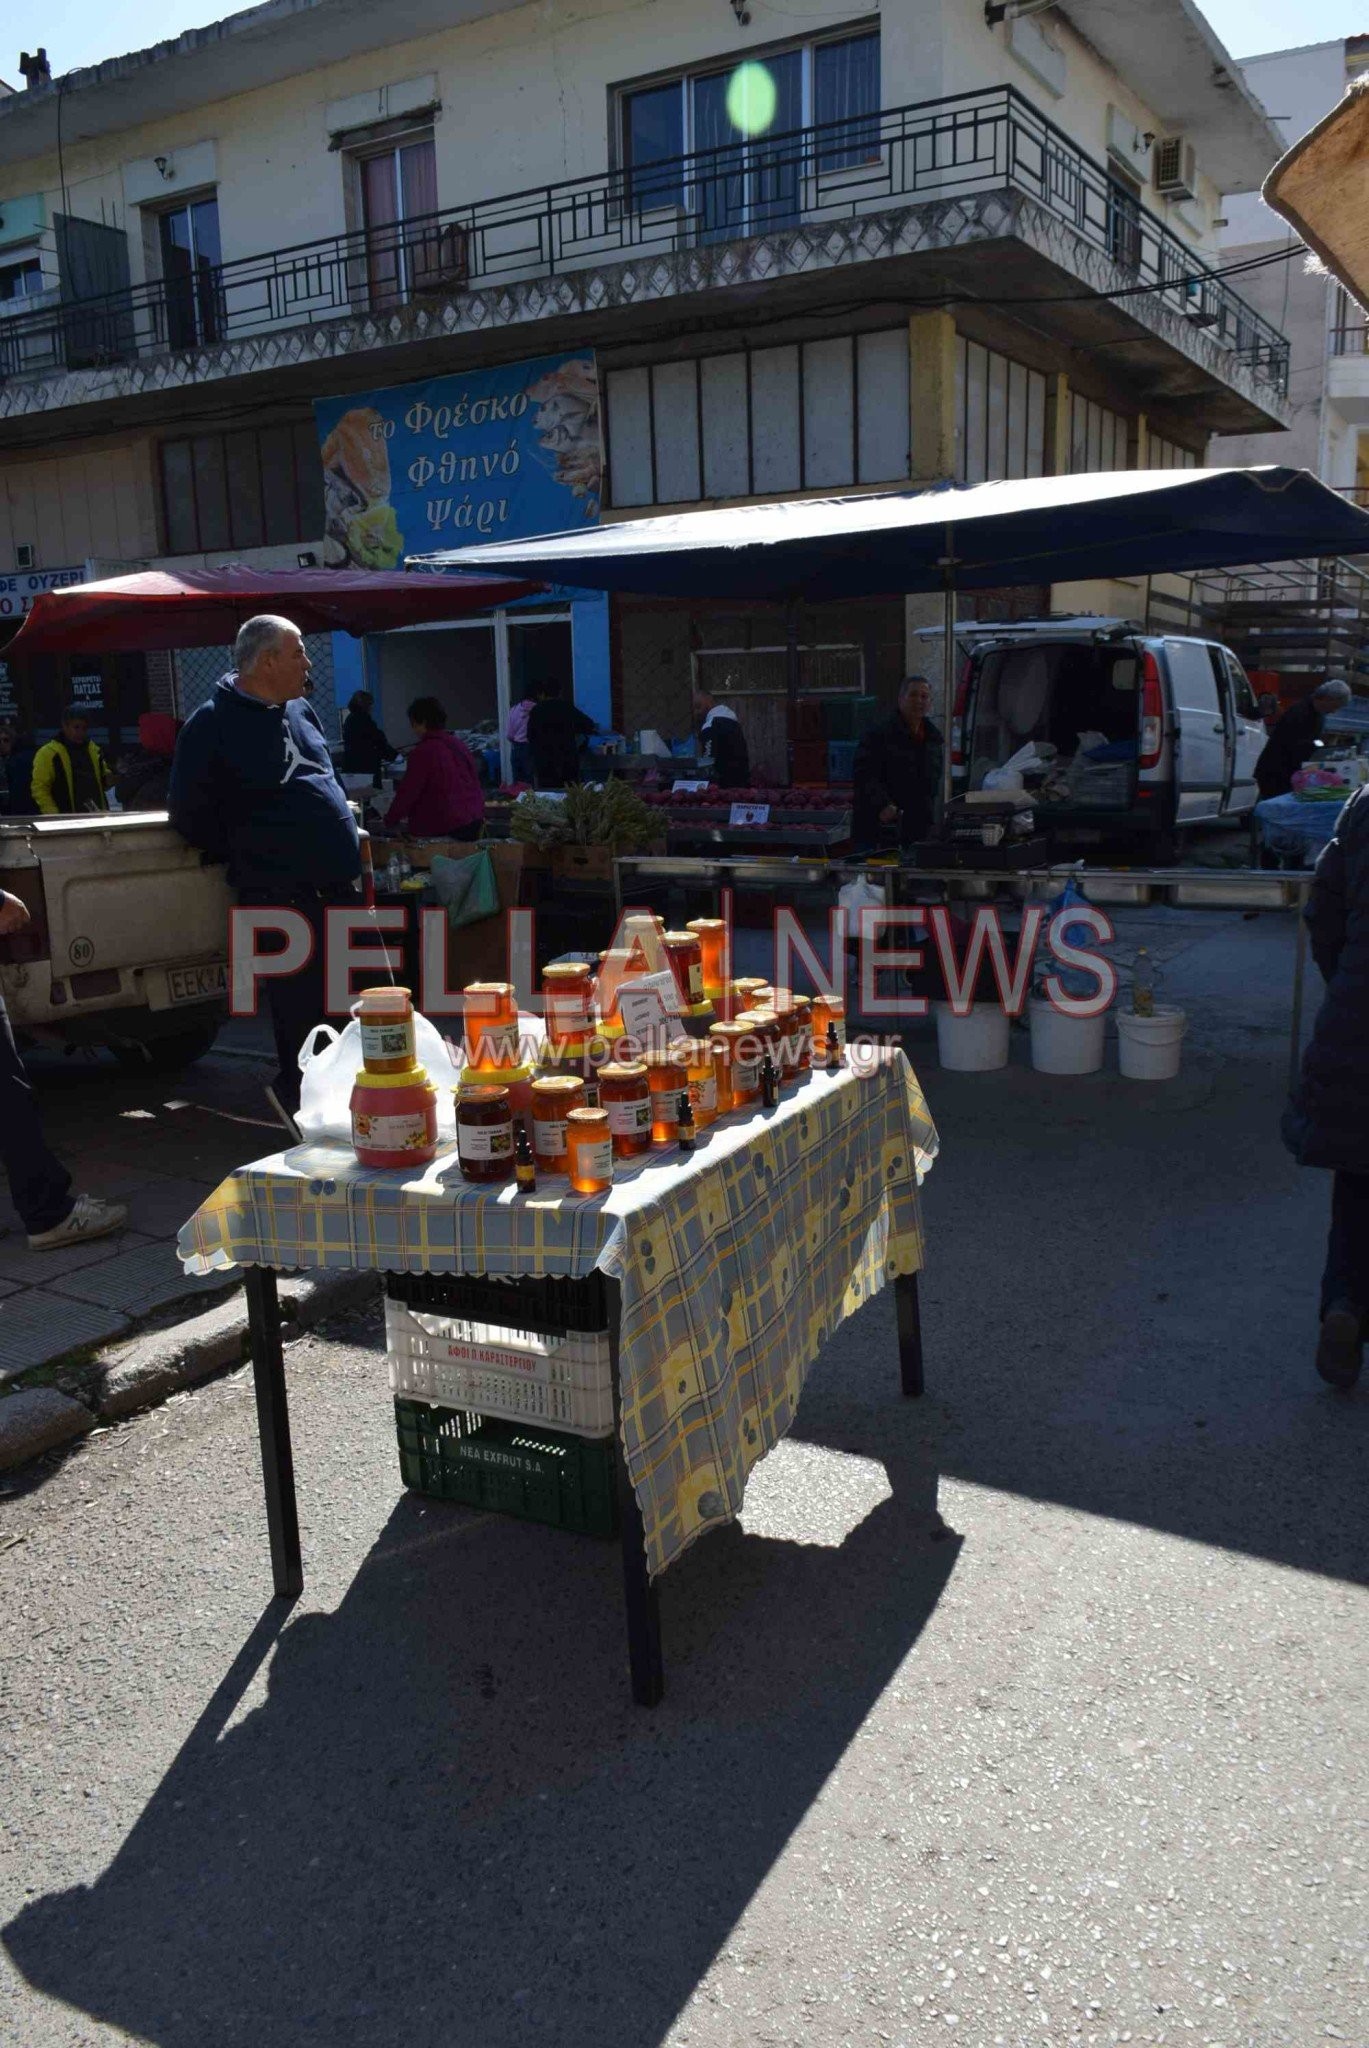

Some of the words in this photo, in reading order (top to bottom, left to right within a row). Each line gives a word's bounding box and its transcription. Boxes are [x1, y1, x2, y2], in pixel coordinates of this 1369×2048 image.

[368, 418, 396, 441] το
[404, 393, 528, 439] Φρέσκο
[407, 440, 520, 488] Φθηνό
[426, 495, 510, 534] Ψάρι
[28, 571, 84, 590] ΟΥΖΕΡΙ
[73, 944, 91, 960] 80
[483, 1450, 521, 1468] EXFRUT
